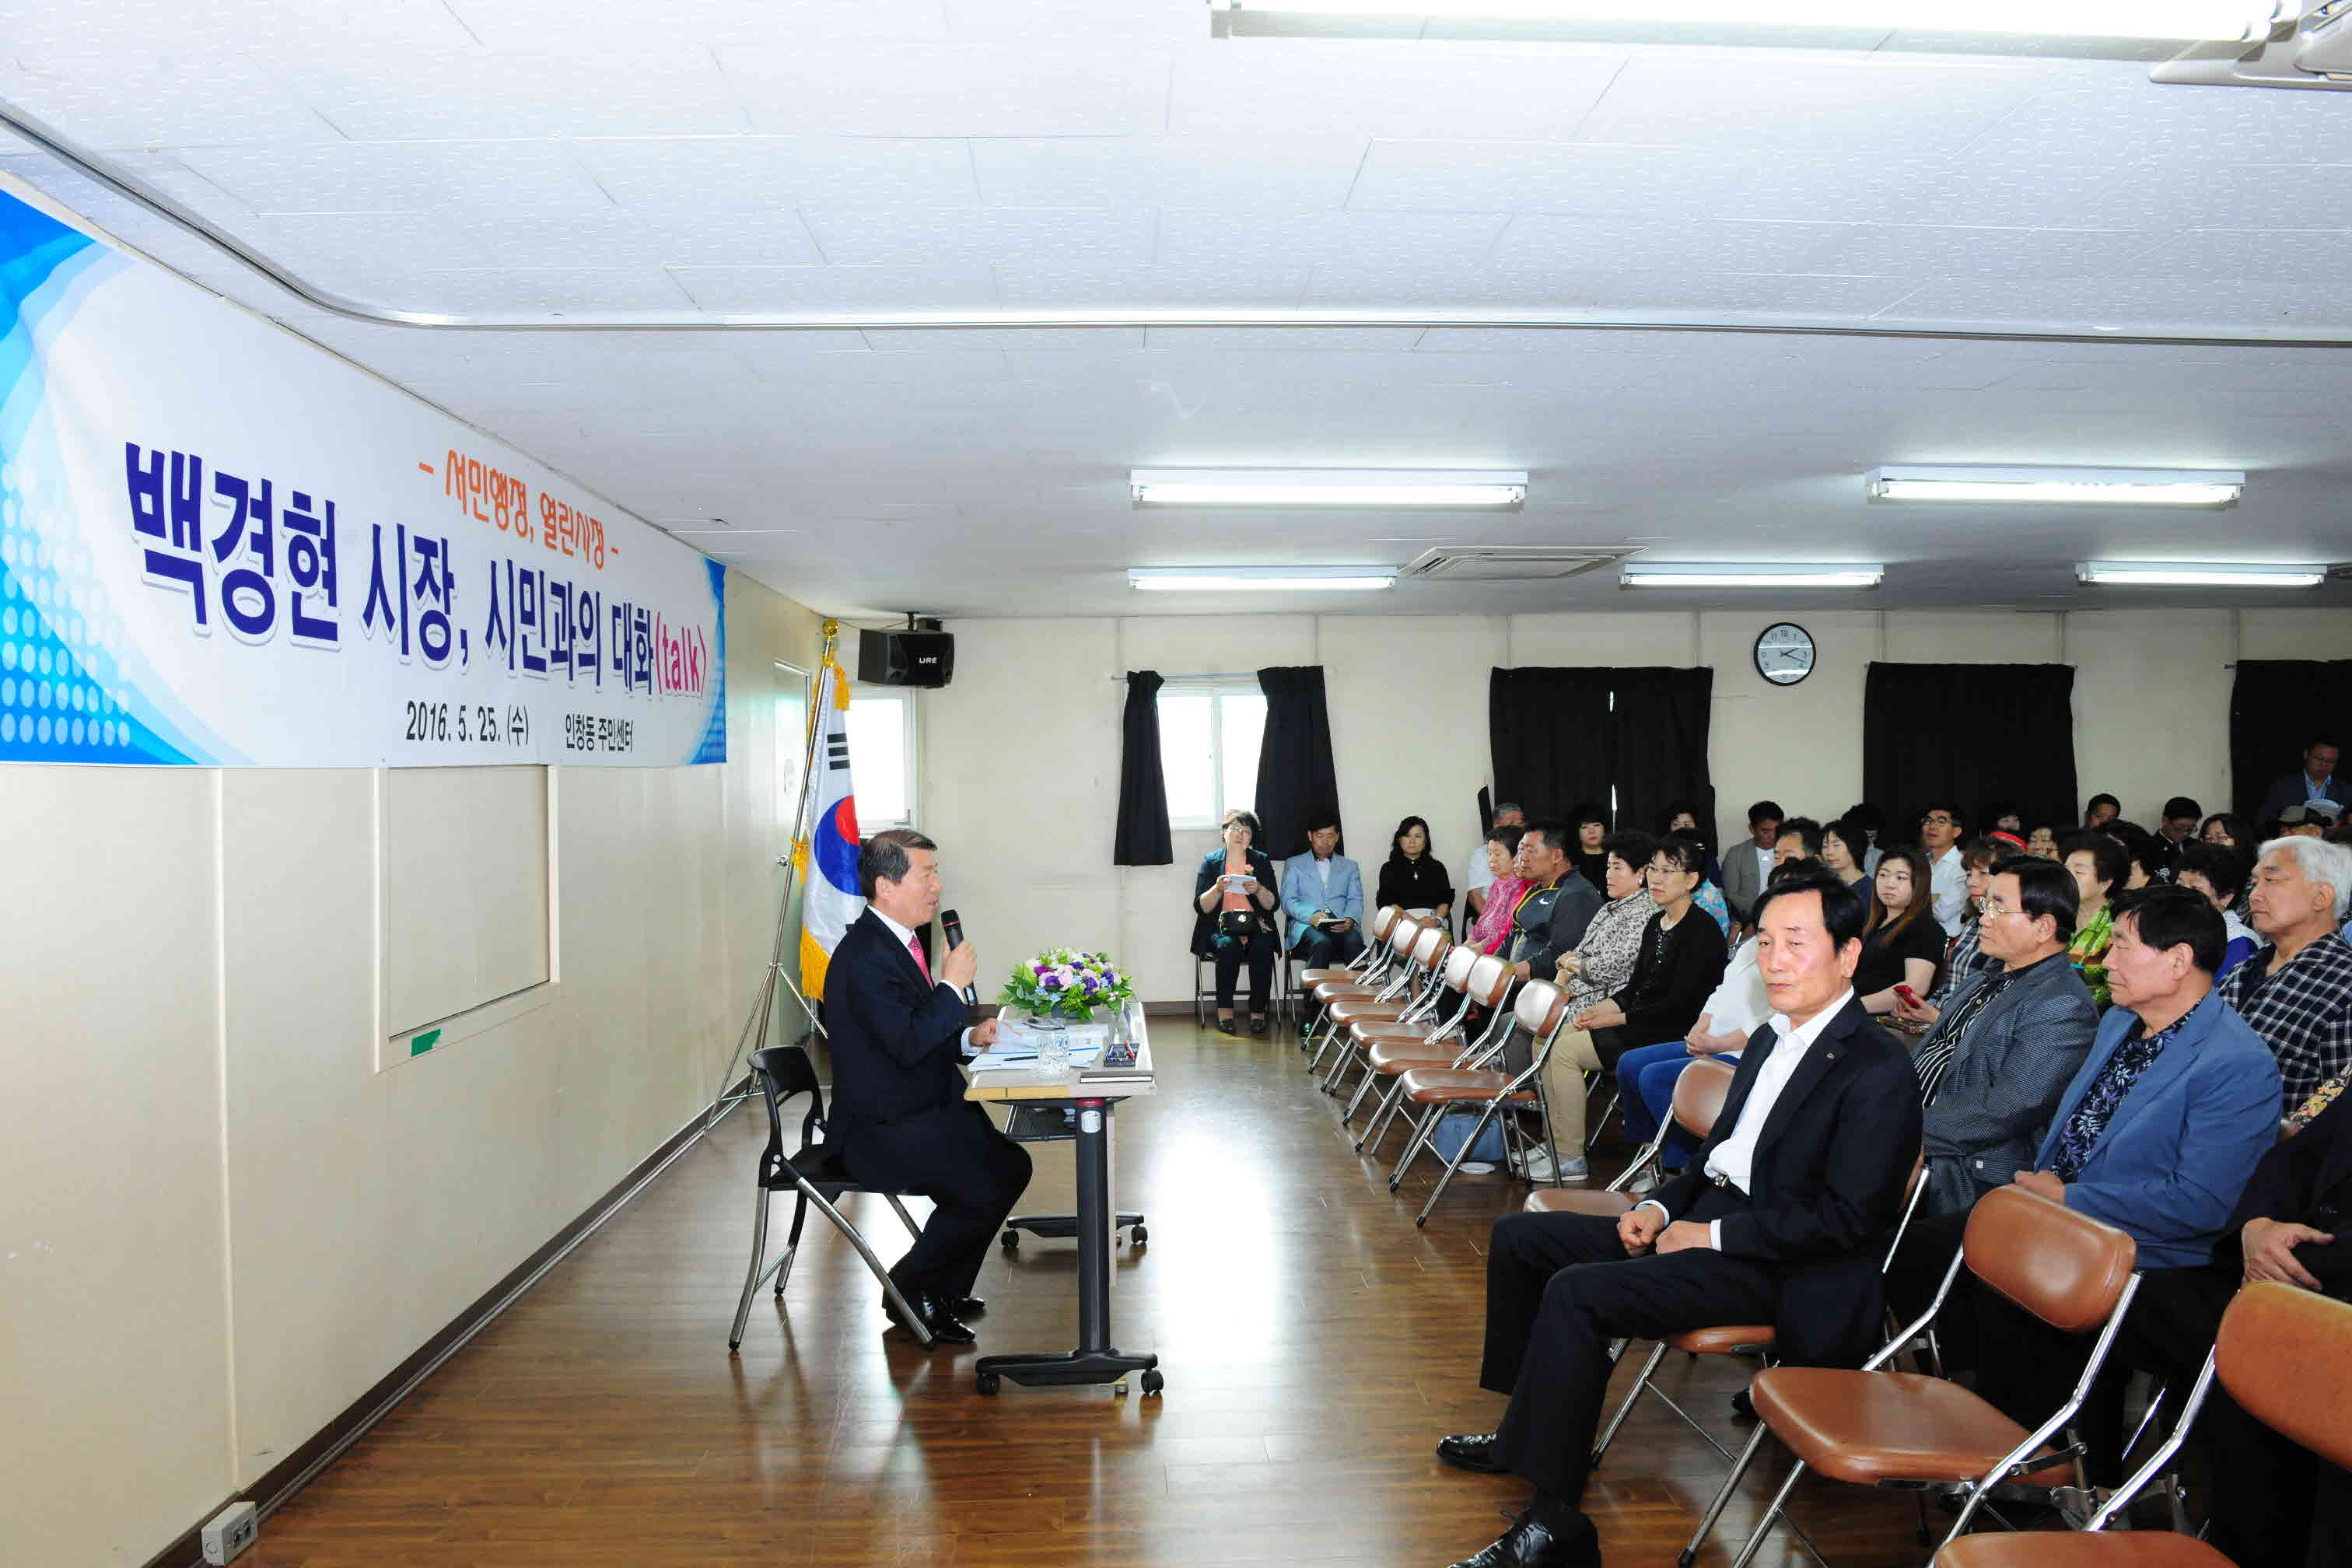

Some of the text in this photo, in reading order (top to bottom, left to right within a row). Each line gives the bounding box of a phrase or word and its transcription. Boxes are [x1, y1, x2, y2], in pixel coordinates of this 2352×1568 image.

[126, 442, 338, 642] 백경현
[362, 523, 468, 667] 시장,
[485, 558, 602, 686] 시민과의
[540, 492, 604, 570] 열린시정
[506, 704, 529, 747] (수)
